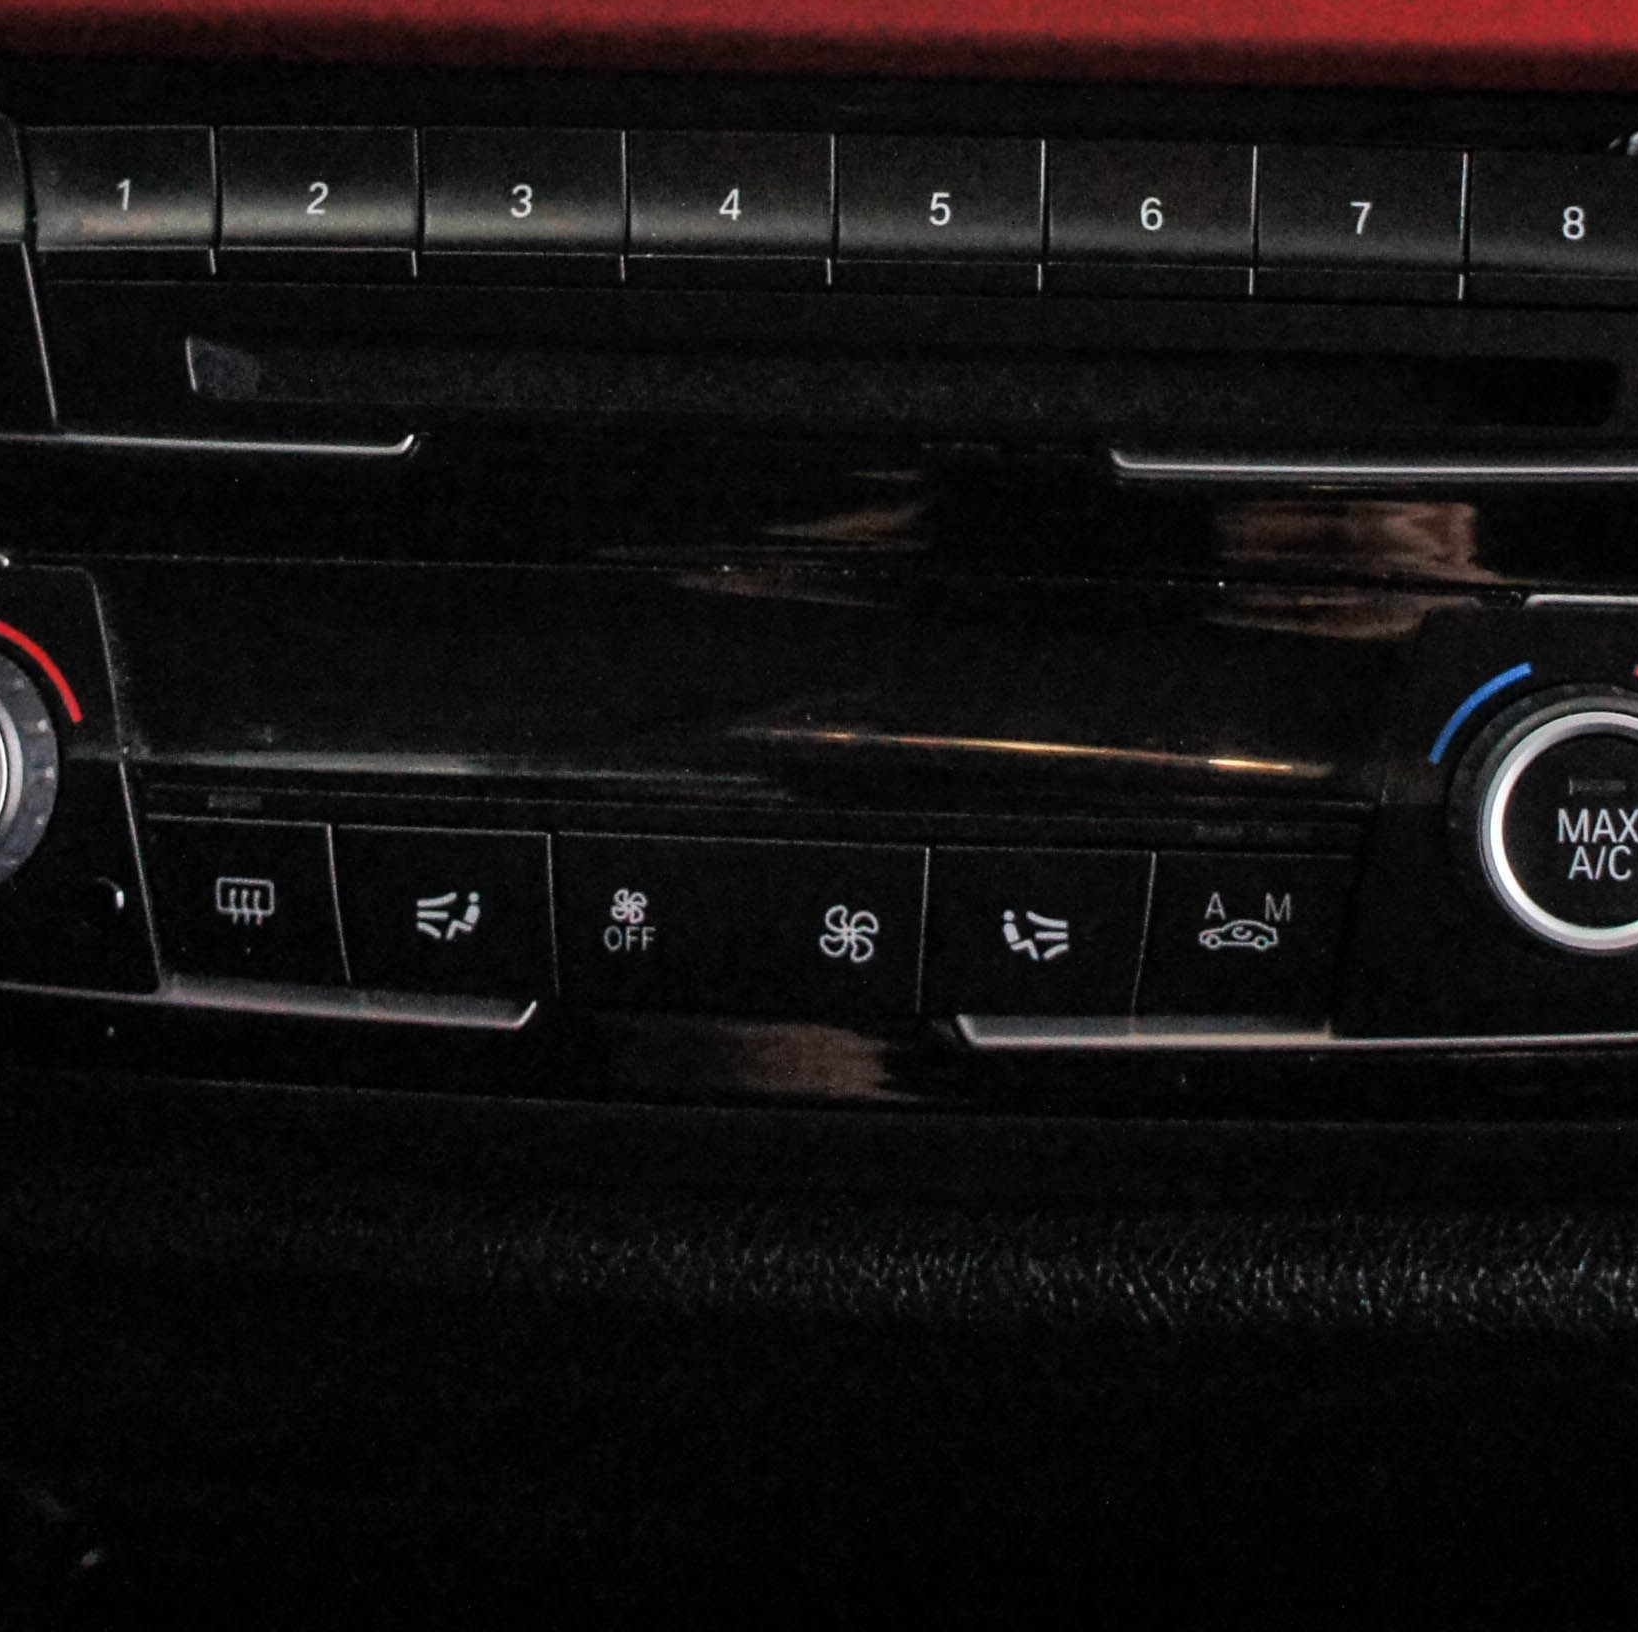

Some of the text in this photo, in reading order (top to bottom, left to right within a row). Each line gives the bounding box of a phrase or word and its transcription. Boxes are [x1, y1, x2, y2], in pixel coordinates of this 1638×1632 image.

[116, 179, 1586, 241] 1 2 3 4 5 6 7 8
[1568, 844, 1633, 882] A/C
[1204, 892, 1293, 923] A M
[603, 925, 657, 953] OFF
